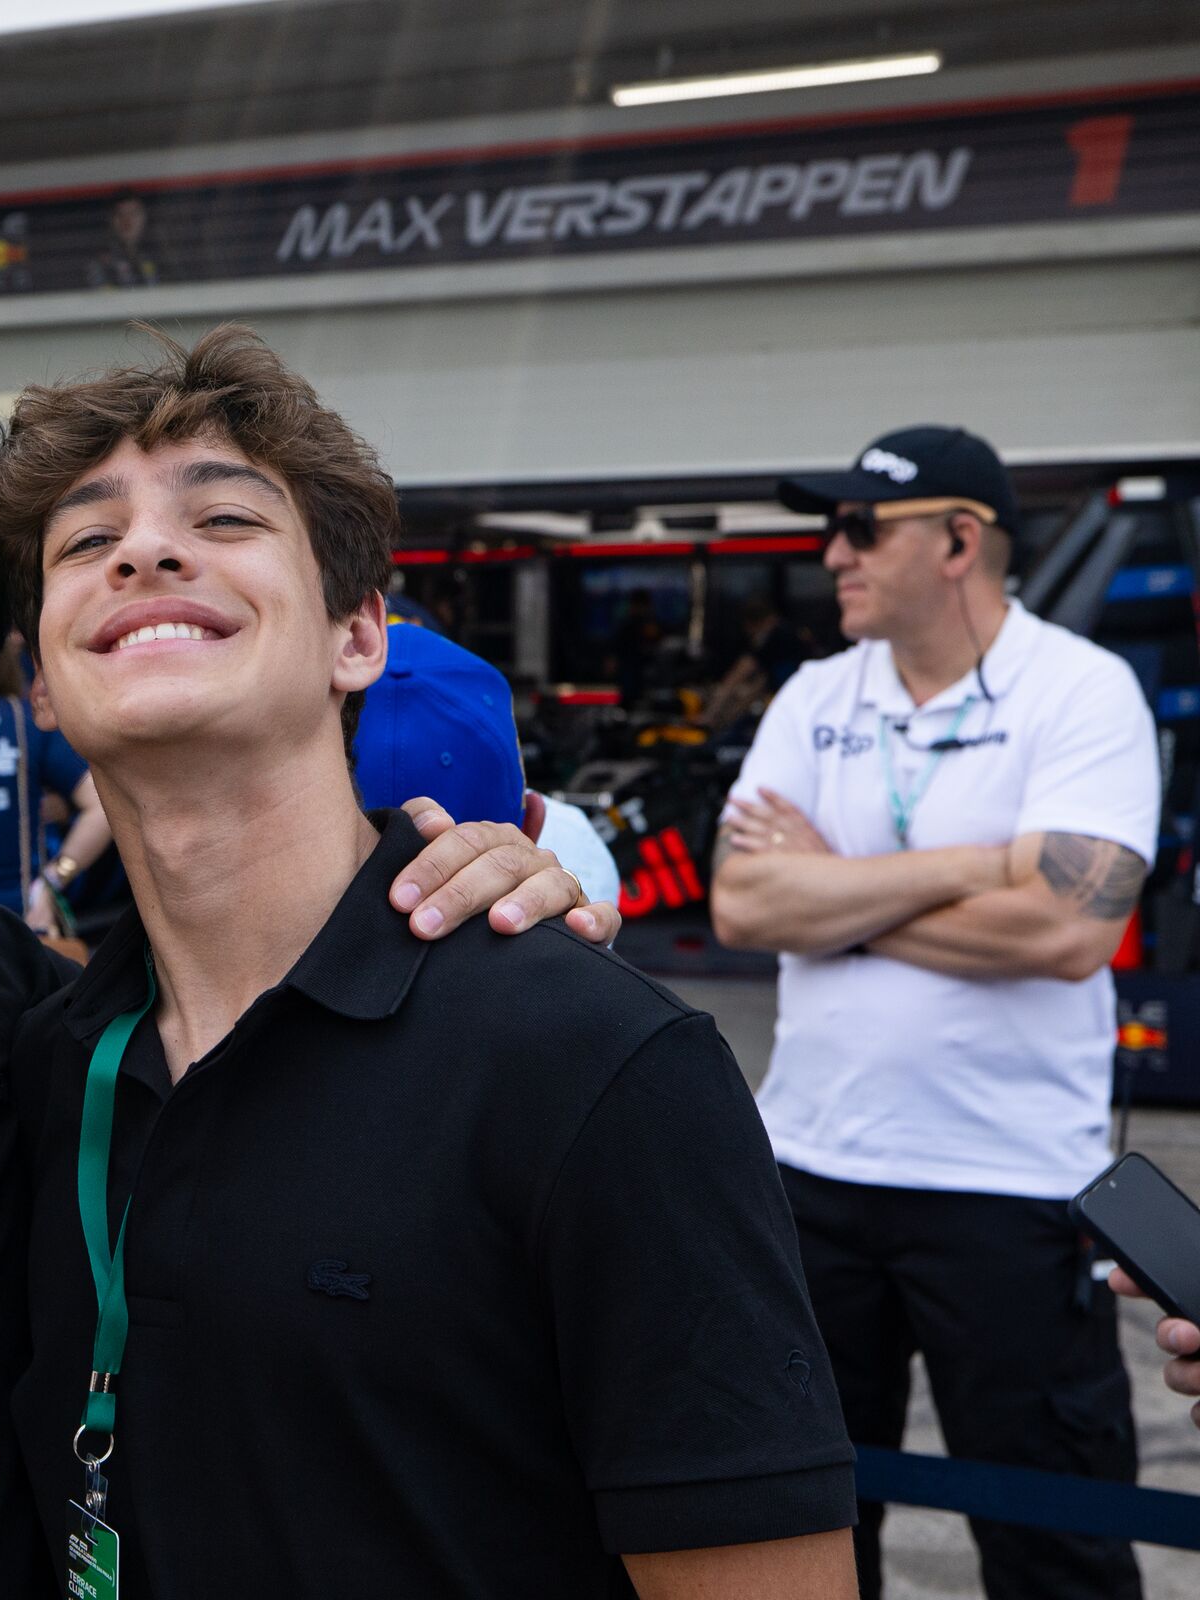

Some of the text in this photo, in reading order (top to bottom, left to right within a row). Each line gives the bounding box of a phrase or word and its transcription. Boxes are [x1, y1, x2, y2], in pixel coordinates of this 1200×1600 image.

[1064, 113, 1134, 207] 1
[277, 148, 971, 262] MAX VERSTAPPEN
[68, 1568, 97, 1599] TERRACE
[68, 1580, 85, 1600] CLUB
